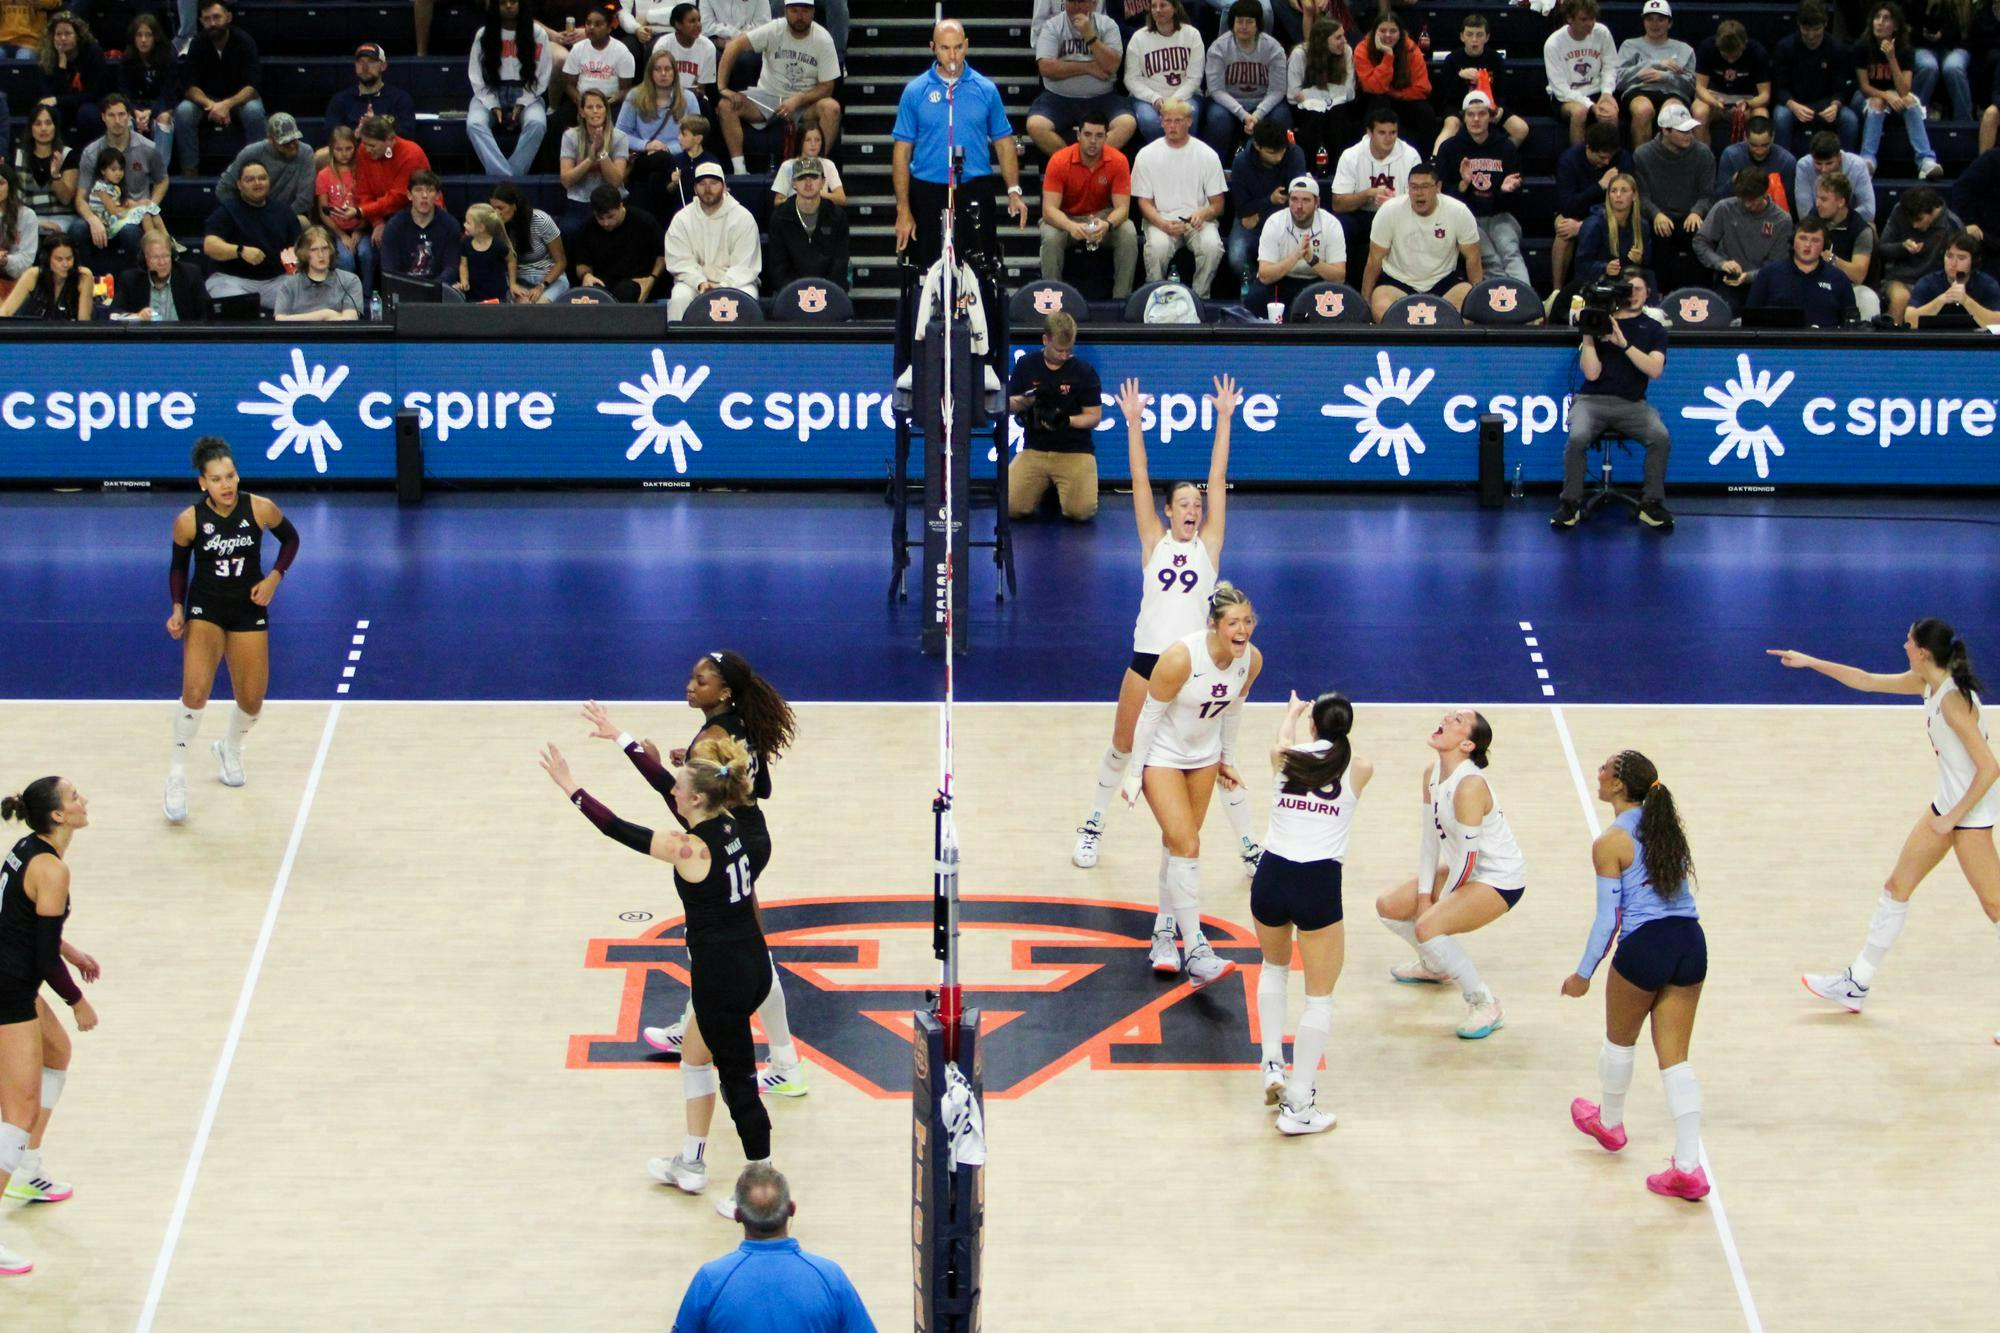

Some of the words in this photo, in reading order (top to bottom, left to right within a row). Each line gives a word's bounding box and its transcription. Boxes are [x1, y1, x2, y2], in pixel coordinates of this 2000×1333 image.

[2, 391, 36, 430] c
[46, 391, 196, 442] spire
[359, 391, 393, 430] c
[404, 391, 555, 442] spire
[720, 392, 754, 430] c
[1443, 394, 1477, 433] c
[1802, 397, 1836, 436] c
[1846, 397, 1997, 448] spire
[203, 534, 254, 556] Aggies
[215, 557, 246, 577] 37
[1158, 568, 1198, 594] 99
[1199, 700, 1231, 719] 17
[1278, 798, 1340, 817] AUBURN
[726, 854, 752, 904] 16
